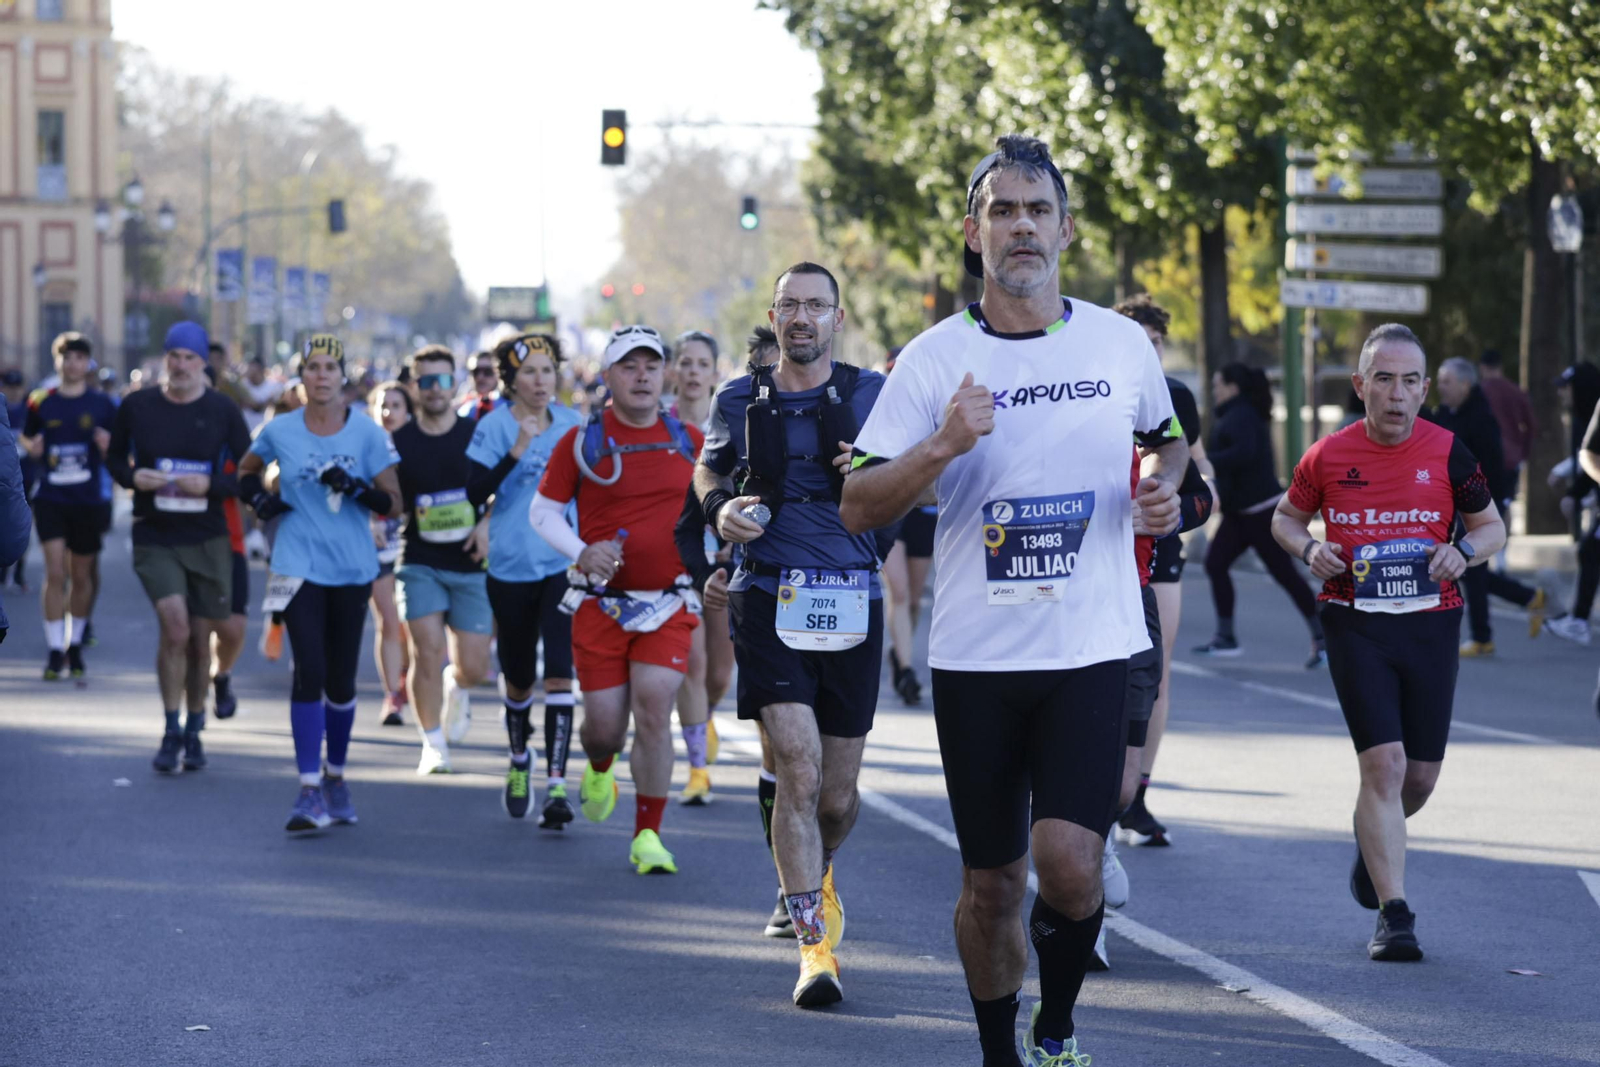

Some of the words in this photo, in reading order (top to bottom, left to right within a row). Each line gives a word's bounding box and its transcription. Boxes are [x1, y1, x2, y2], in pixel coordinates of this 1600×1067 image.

[1020, 499, 1083, 518] ZURICH
[1378, 525, 1427, 536] ATLETISMO
[1020, 532, 1063, 550] 13493
[1381, 565, 1413, 577] 13040
[811, 575, 859, 586] ZURICH
[1377, 580, 1418, 597] LUIGI
[811, 598, 837, 609] 7074
[806, 613, 838, 630] SEB
